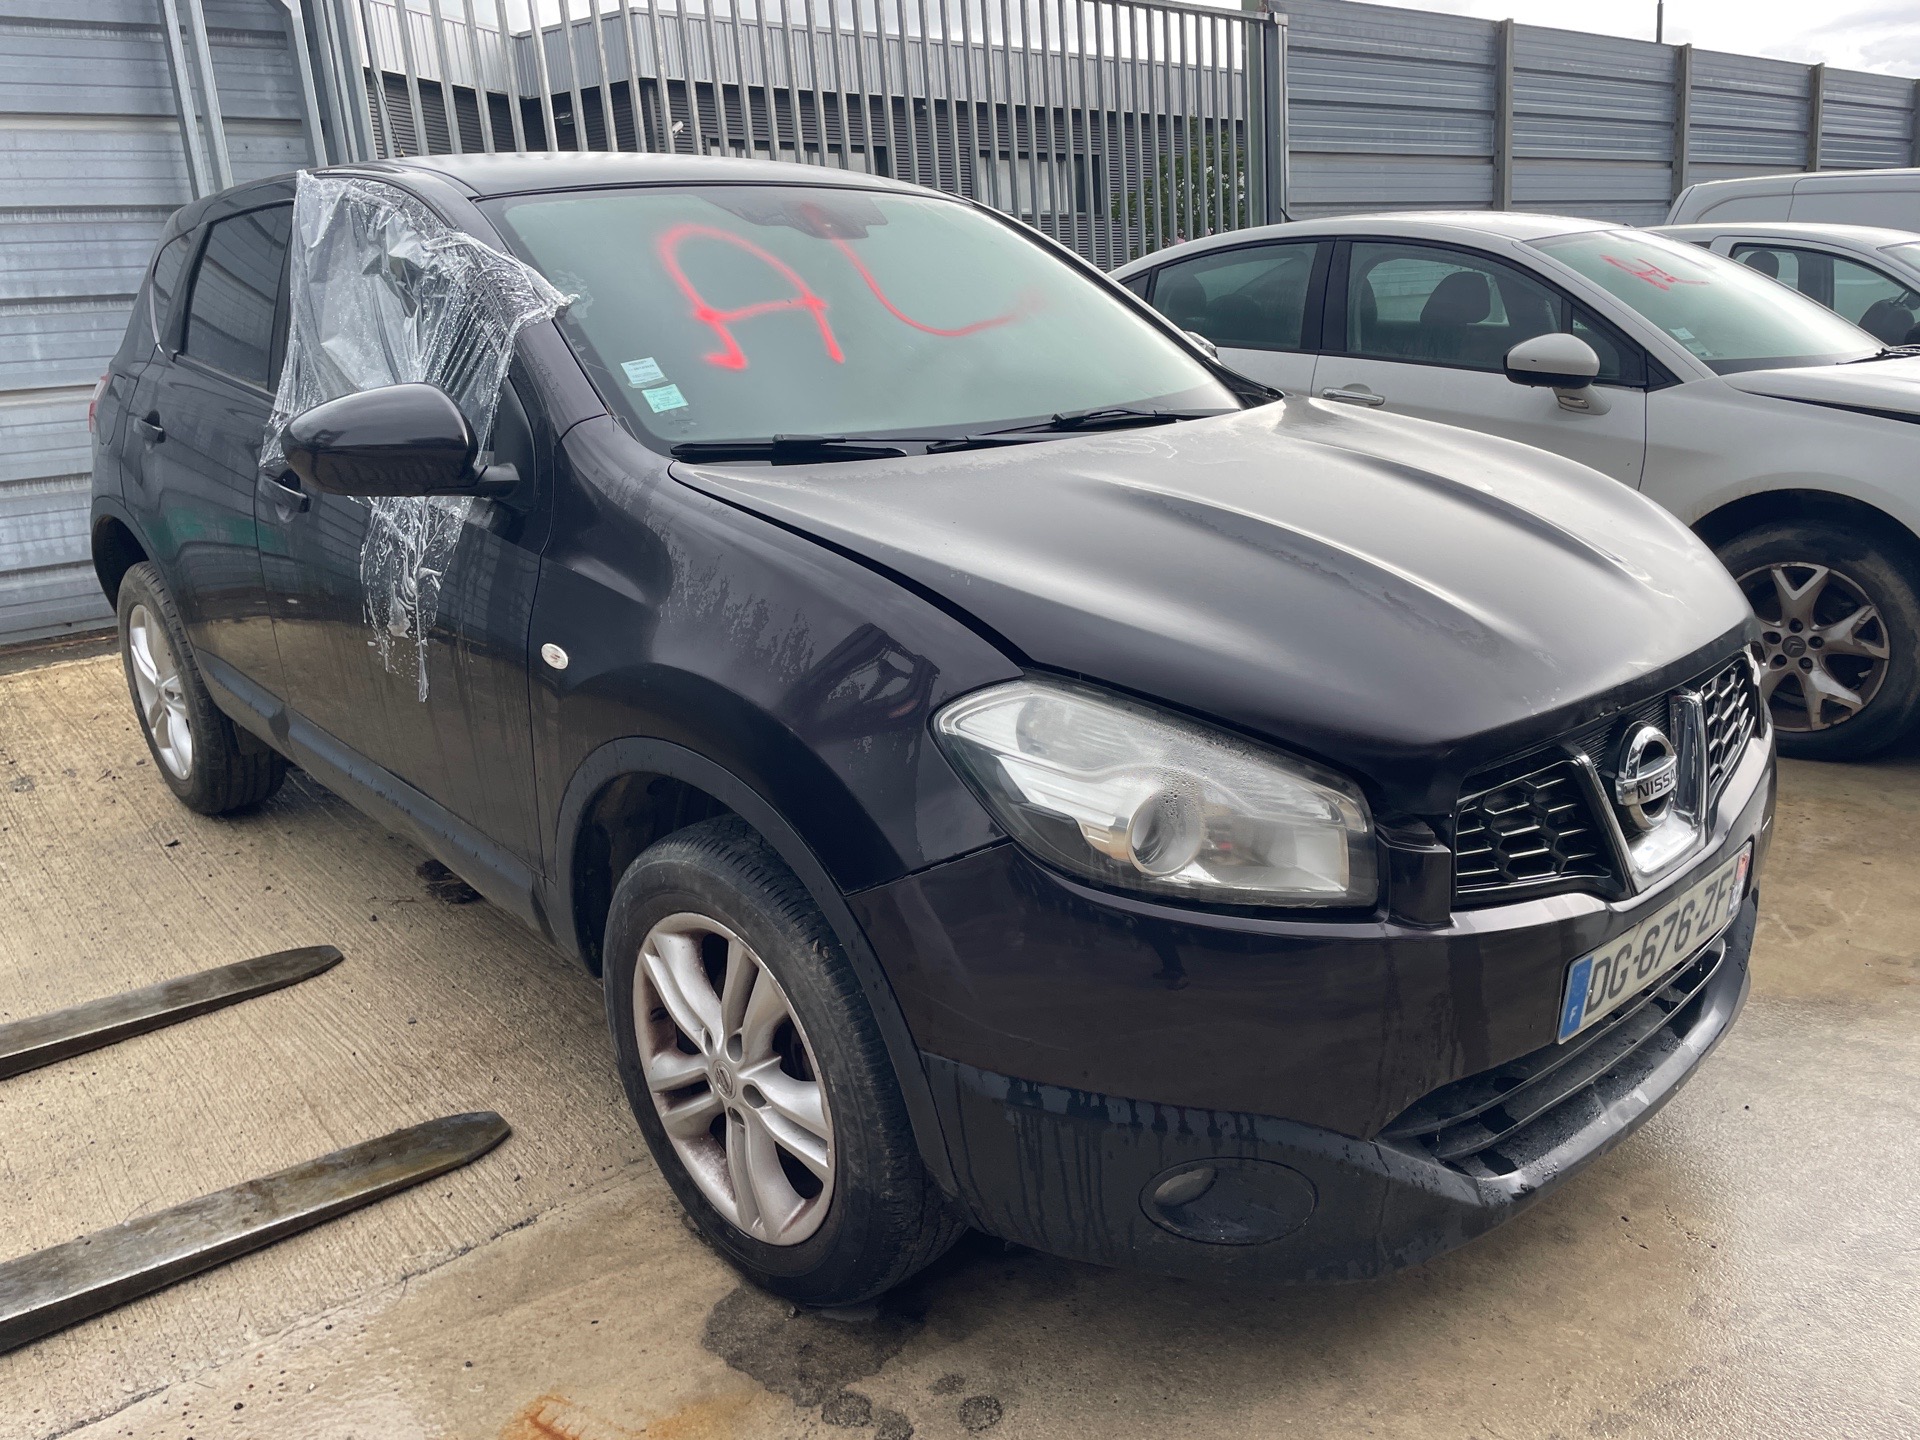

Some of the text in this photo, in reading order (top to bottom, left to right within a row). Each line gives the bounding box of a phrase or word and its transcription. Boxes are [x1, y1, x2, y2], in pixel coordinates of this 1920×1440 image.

[1637, 768, 1676, 799] NISSA
[1584, 866, 1734, 1017] DG-676-ZF
[1569, 1005, 1578, 1024] F
